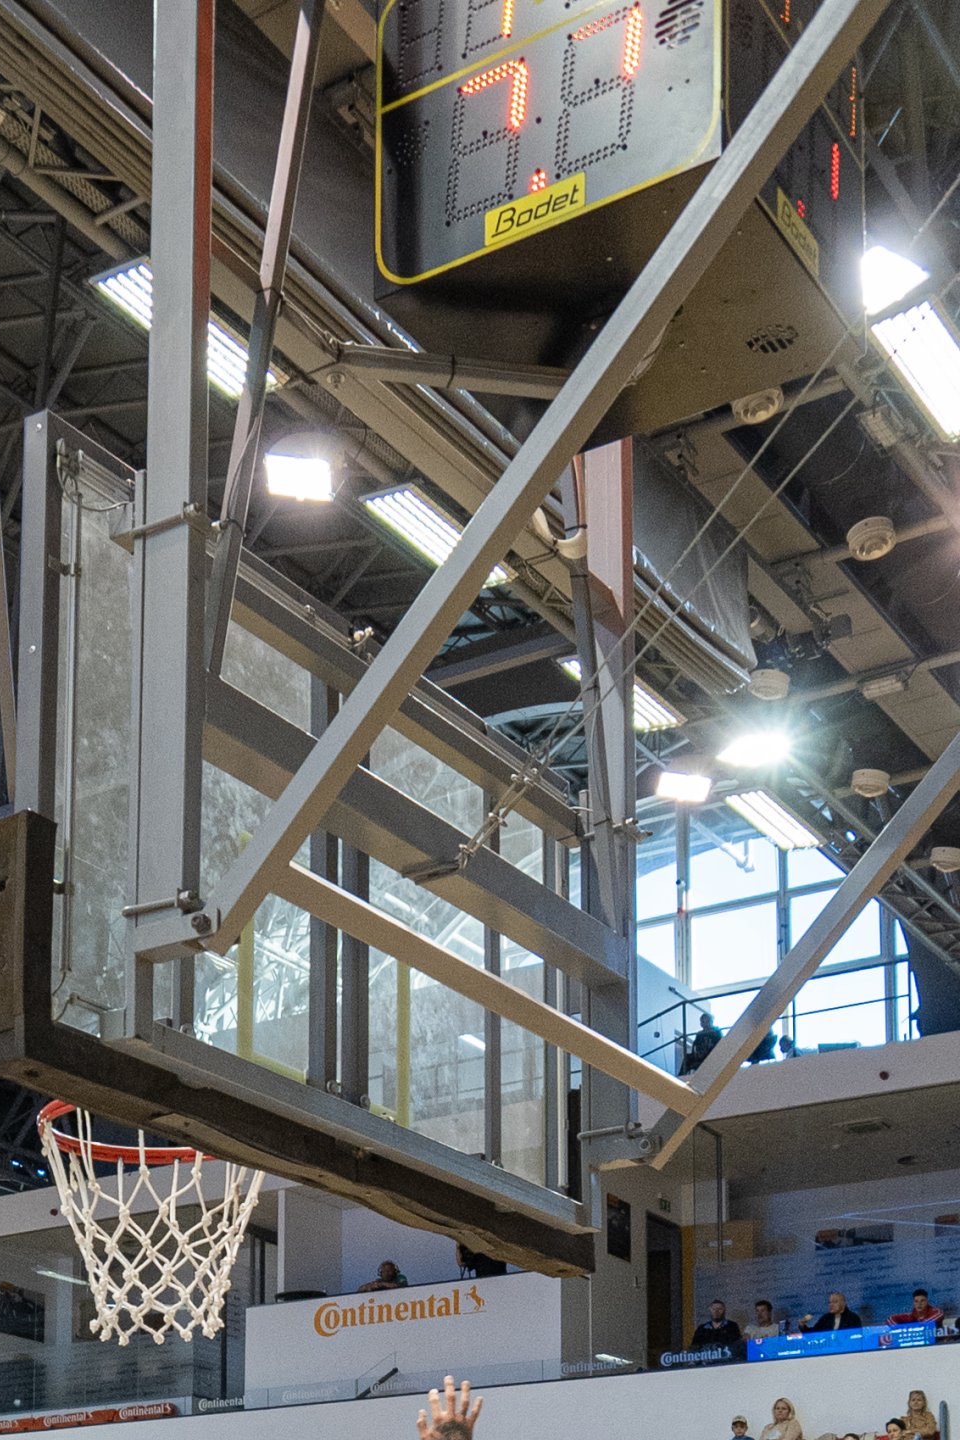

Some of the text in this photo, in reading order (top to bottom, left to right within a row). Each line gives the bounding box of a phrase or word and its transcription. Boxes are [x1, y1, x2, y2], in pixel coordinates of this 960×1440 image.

[491, 184, 580, 238] Bodet
[313, 1288, 462, 1338] Continental
[660, 1347, 722, 1367] Continental
[119, 1403, 164, 1419] Continental
[198, 1396, 245, 1412] Continental
[43, 1412, 86, 1427] Continental
